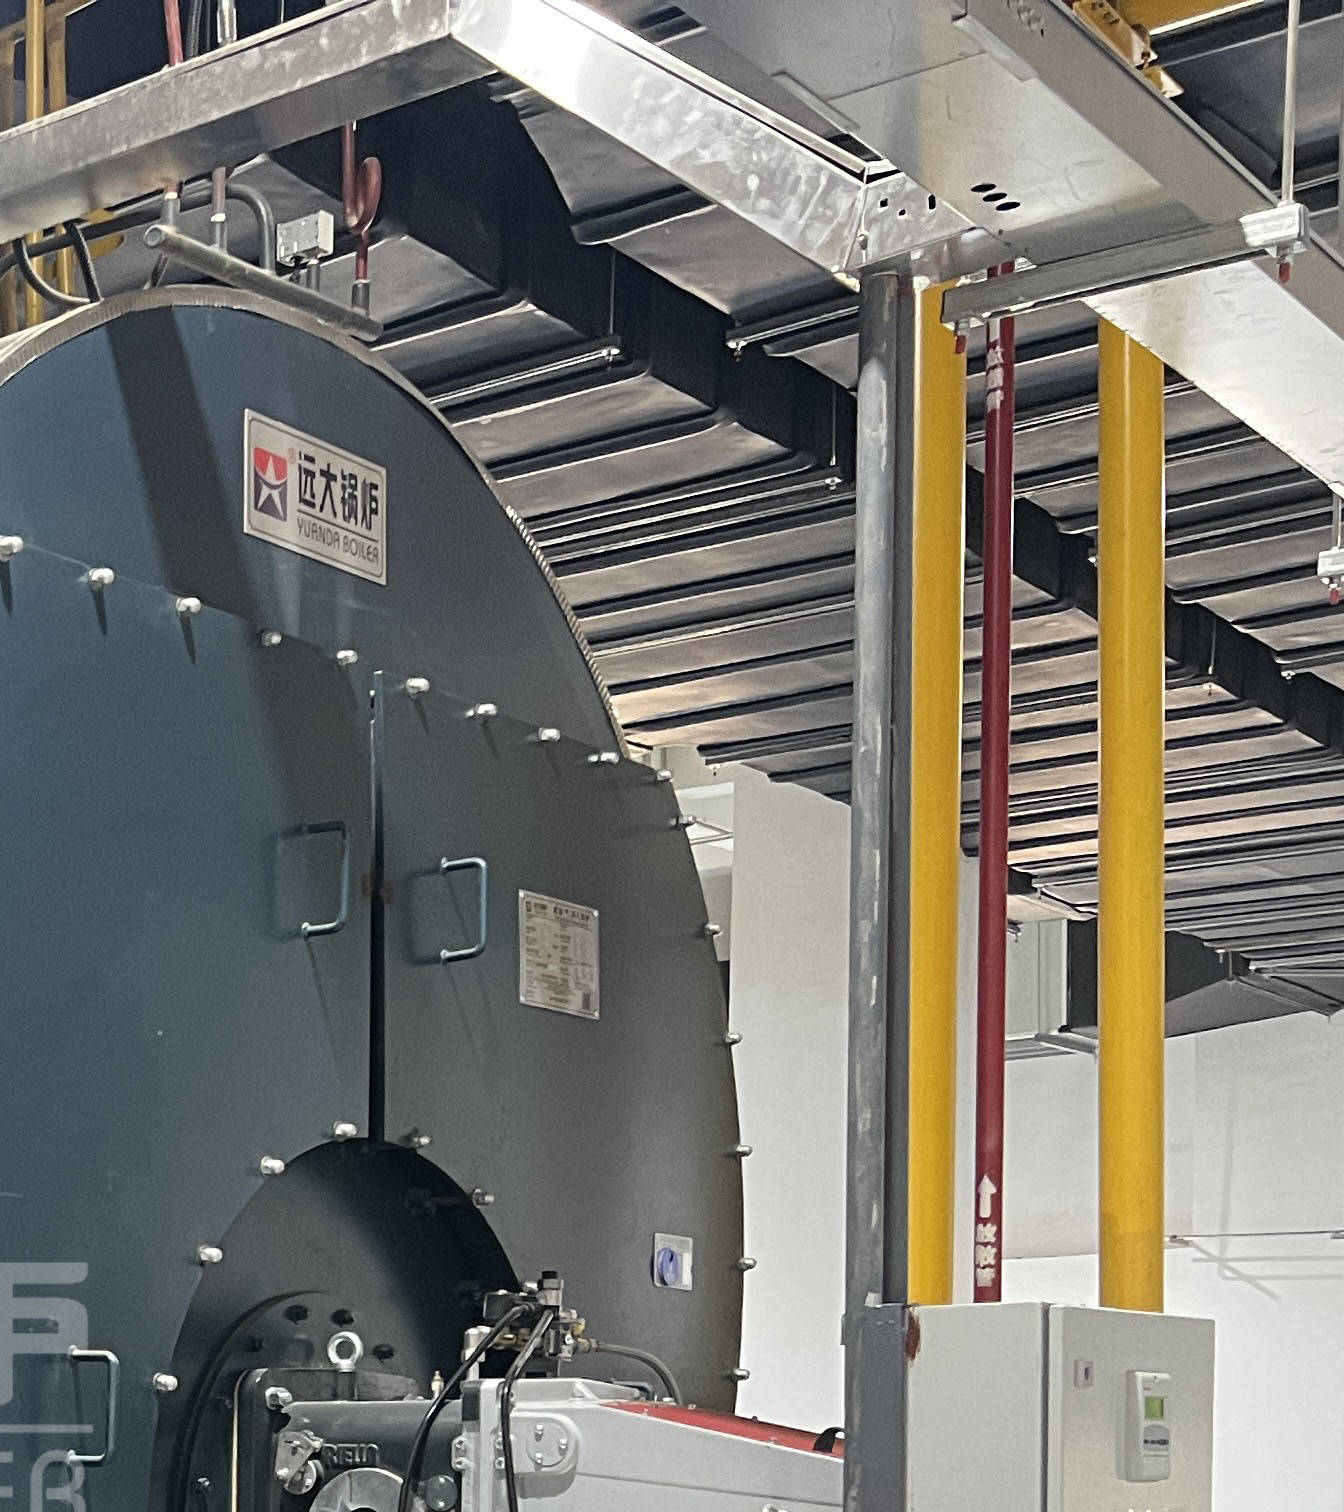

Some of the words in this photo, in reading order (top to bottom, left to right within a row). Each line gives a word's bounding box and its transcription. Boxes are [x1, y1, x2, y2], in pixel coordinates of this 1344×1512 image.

[298, 450, 379, 531] 远大锅炉
[297, 517, 340, 550] YUANDA
[342, 534, 379, 564] BOILER
